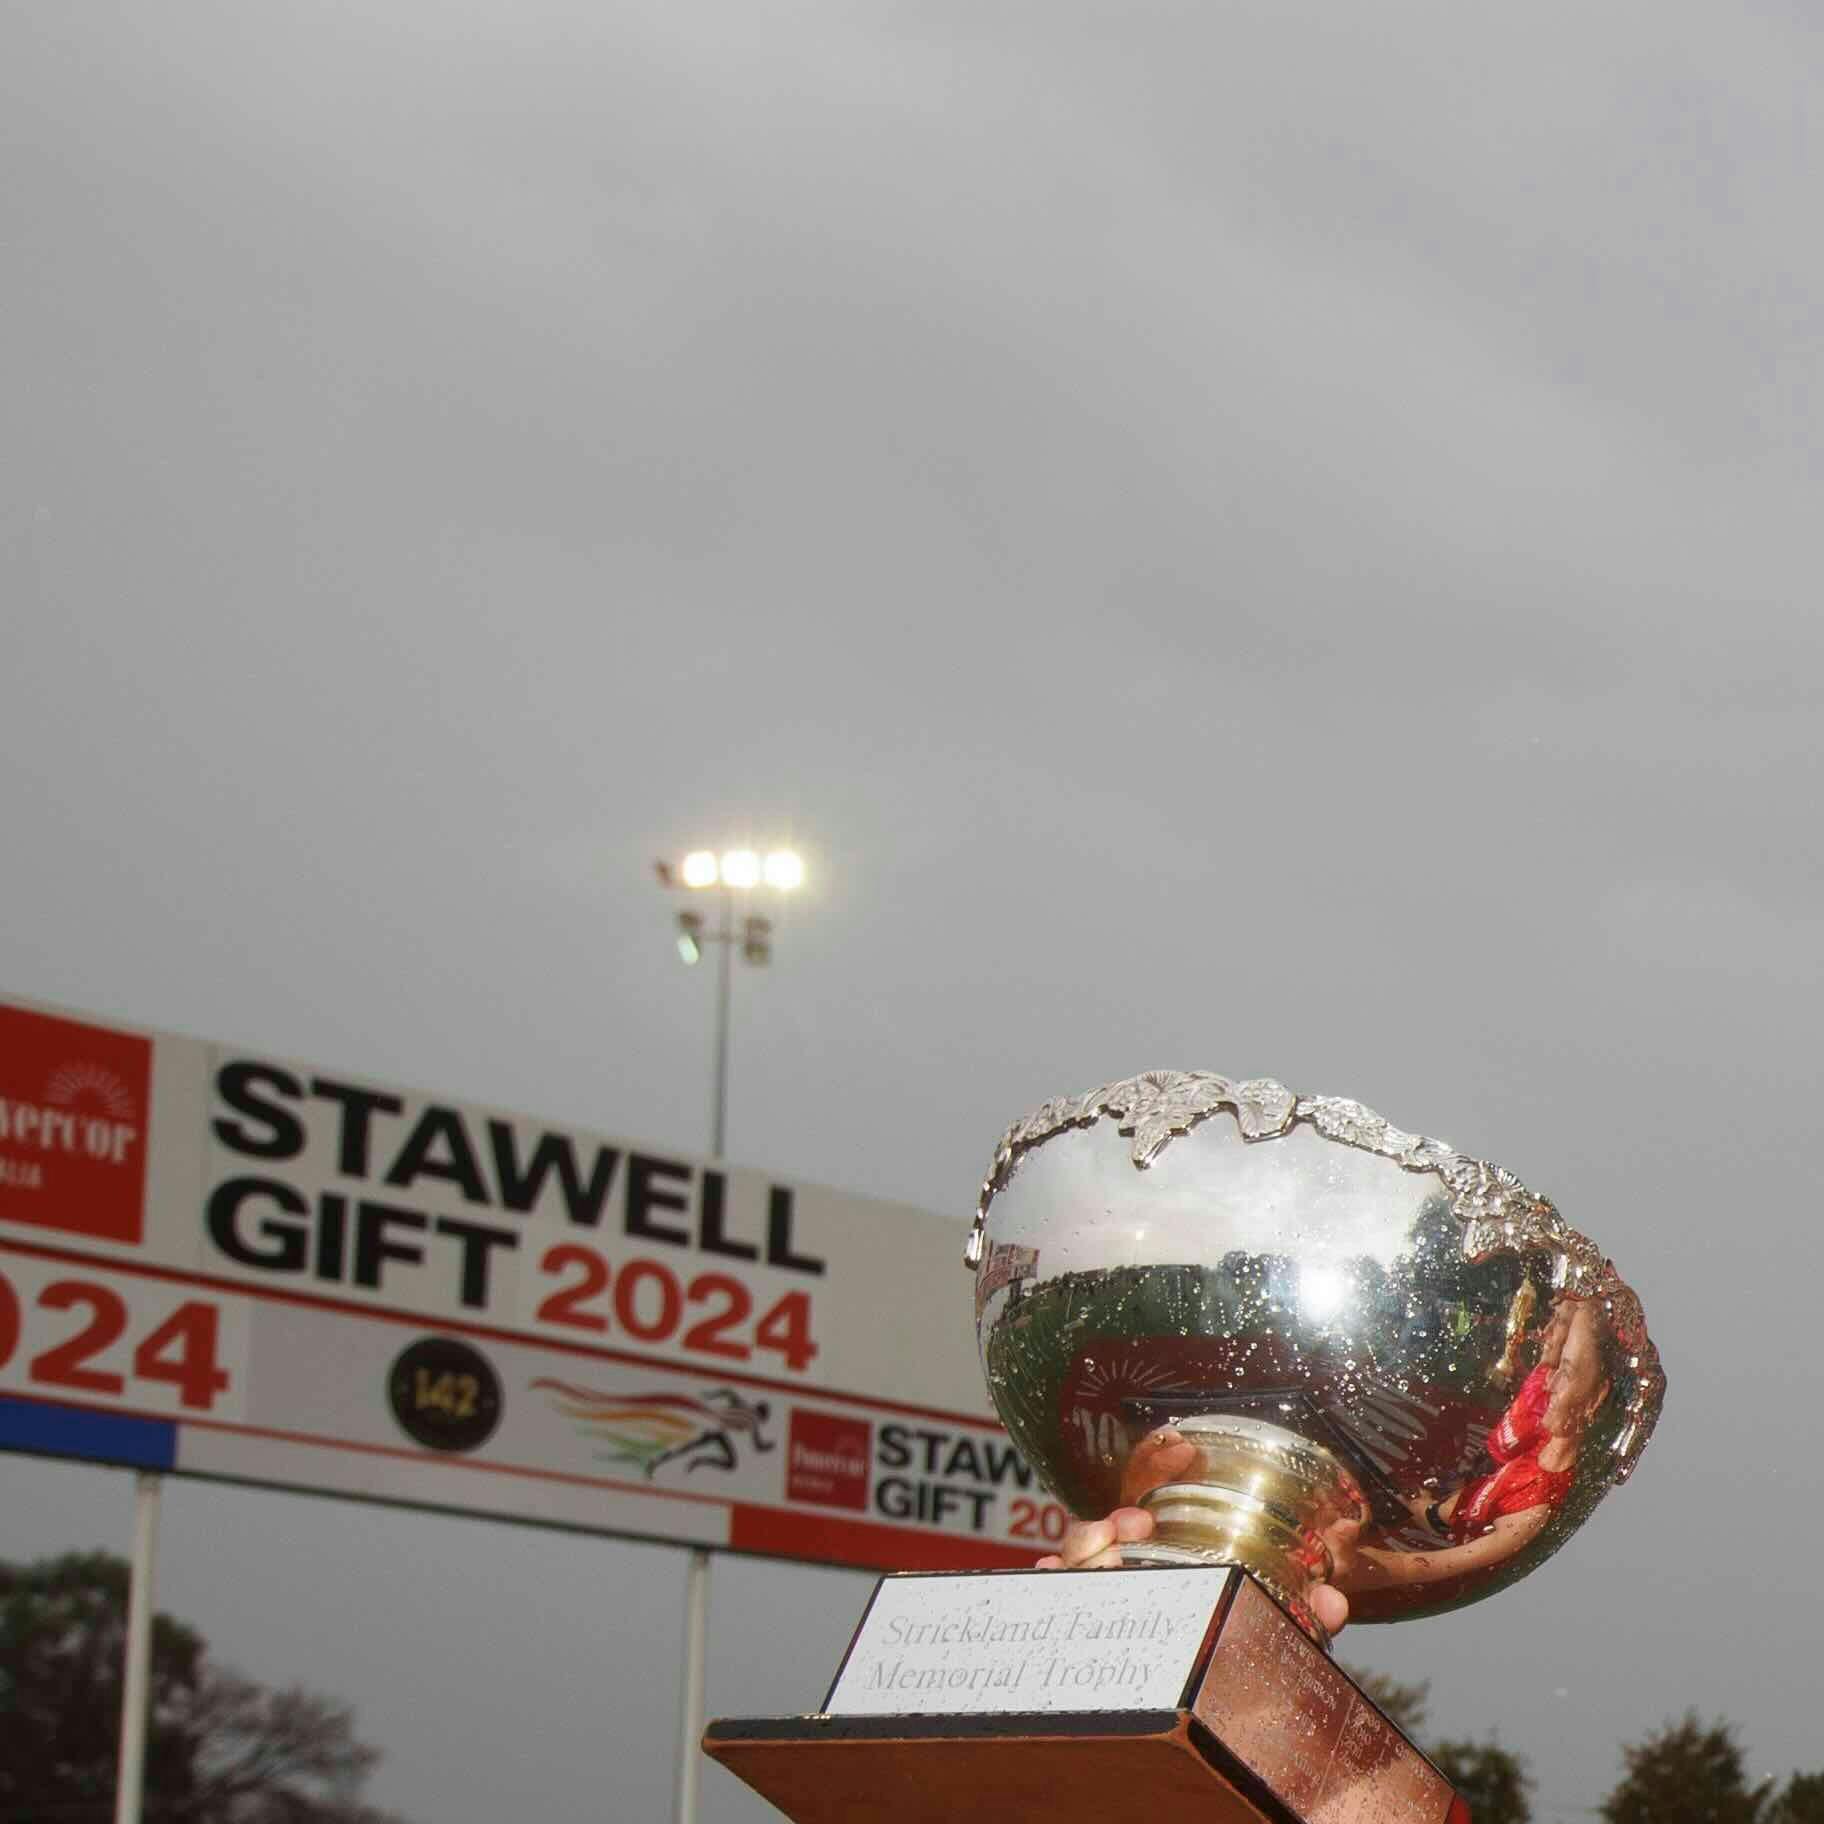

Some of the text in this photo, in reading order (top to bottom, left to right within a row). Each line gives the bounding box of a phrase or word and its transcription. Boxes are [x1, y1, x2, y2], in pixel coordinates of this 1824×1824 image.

[211, 1058, 825, 1274] STAWELL
[205, 1178, 819, 1372] GIFT 2024
[0, 1271, 229, 1411] 24
[879, 1422, 1046, 1490] STAW
[875, 1477, 1069, 1542] GIFT 20
[881, 1610, 1177, 1648] Strickland Family
[863, 1654, 1160, 1693] Memorial Trophy
